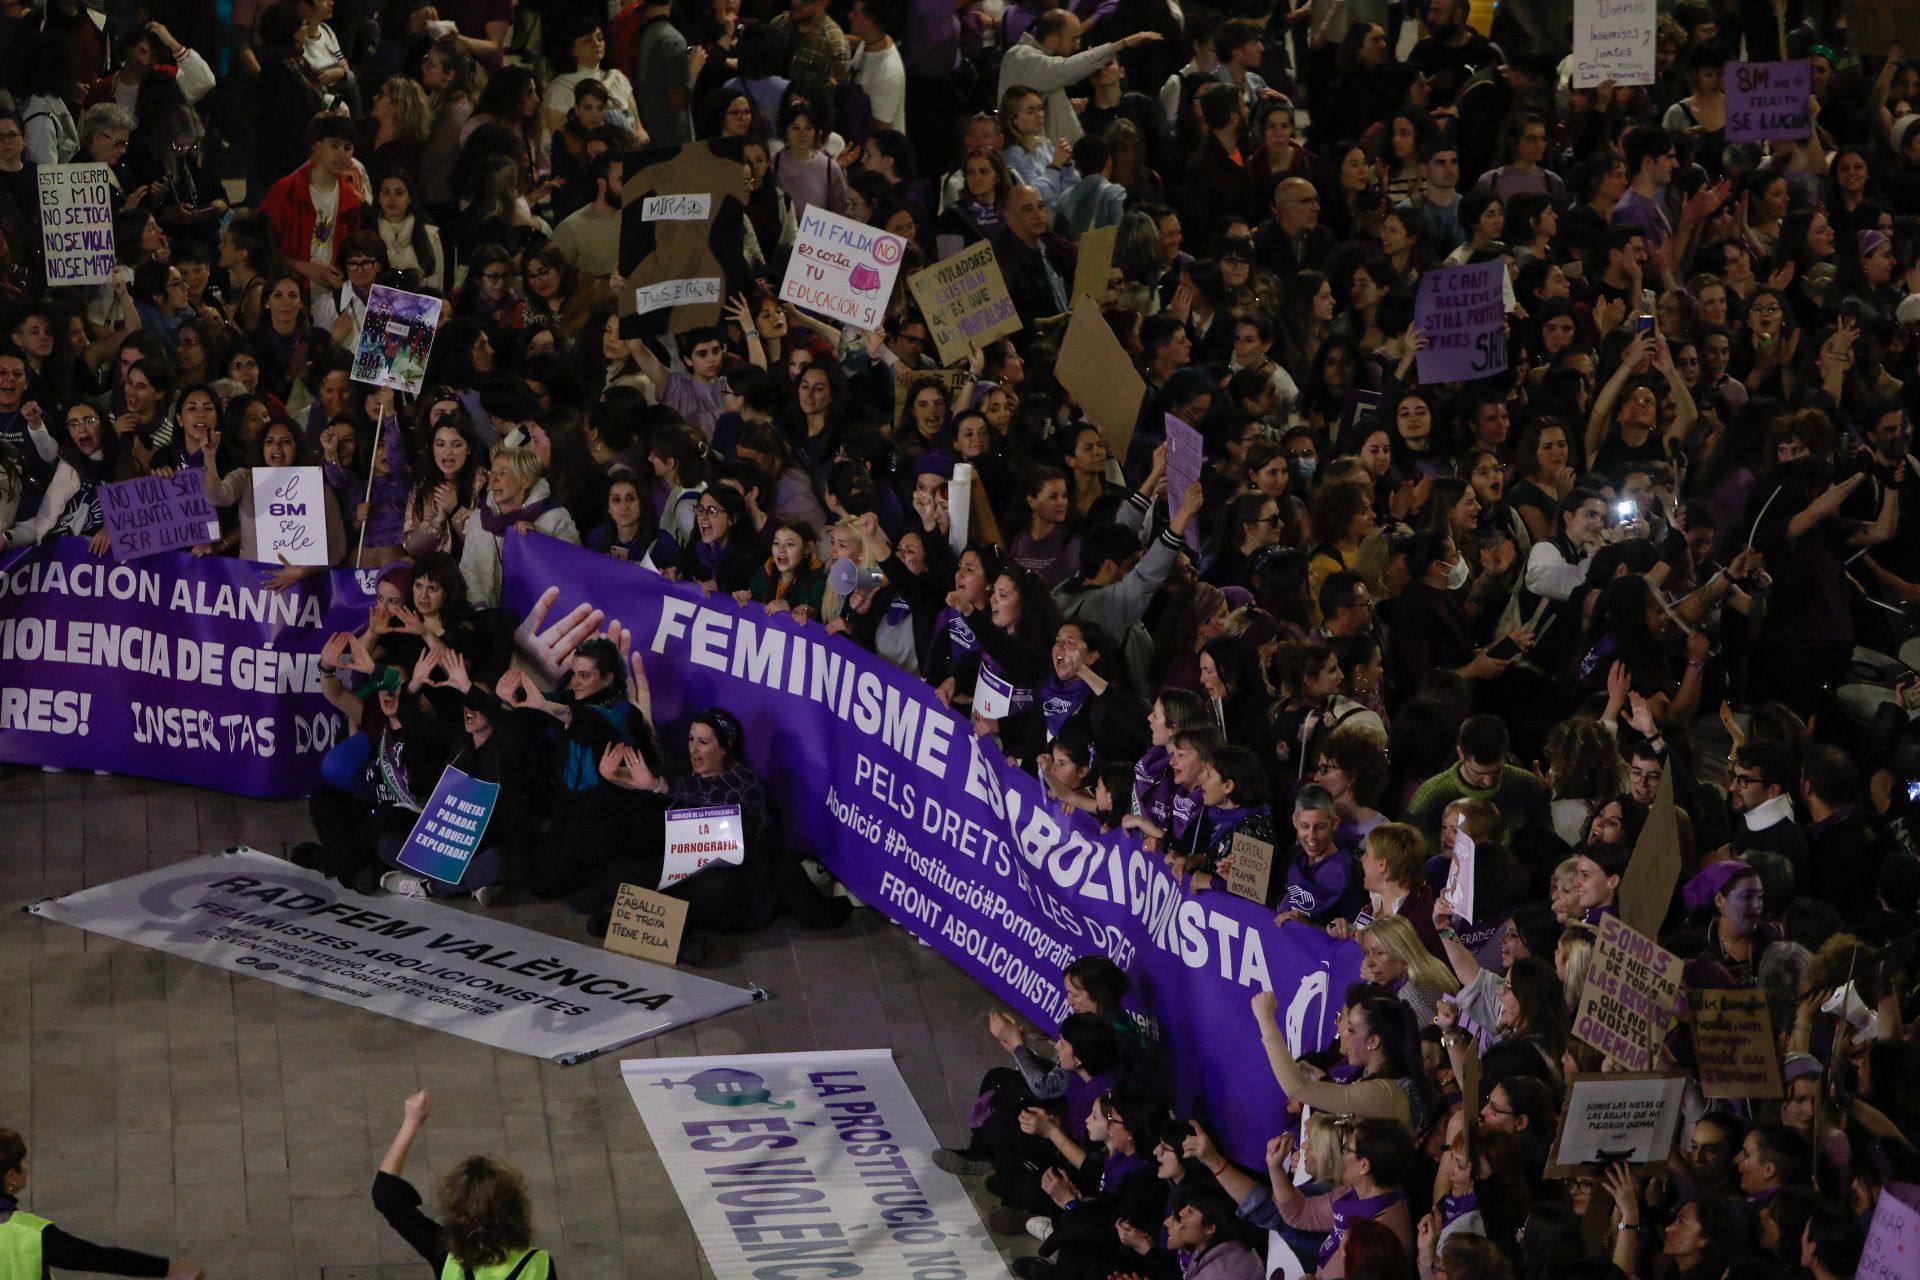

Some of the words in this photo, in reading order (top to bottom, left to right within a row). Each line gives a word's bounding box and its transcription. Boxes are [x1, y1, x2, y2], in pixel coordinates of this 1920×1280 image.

[1736, 67, 1770, 92] 8M
[1731, 112, 1752, 132] SE
[39, 172, 64, 186] ESTE
[70, 169, 109, 185] CUERPO
[42, 190, 59, 206] ES
[71, 185, 106, 206] MIO
[43, 208, 61, 227] NO
[802, 215, 826, 238] MI
[828, 224, 873, 254] FALDA
[876, 242, 898, 261] NO
[798, 243, 814, 254] es
[816, 248, 852, 269] corta
[935, 246, 994, 286] VIOLADORES
[805, 263, 825, 281] TU
[1431, 275, 1442, 293] I
[1447, 270, 1489, 291] CANT
[1435, 290, 1491, 310] BELIEVE
[862, 307, 877, 325] SI
[1423, 311, 1463, 330] STILL
[1424, 332, 1471, 351] THIS
[356, 365, 379, 380] 2023
[360, 351, 381, 369] 8M
[107, 485, 130, 512] NO
[134, 478, 172, 505] VULL
[171, 472, 203, 497] SER
[275, 475, 300, 501] el
[108, 503, 174, 532] VALENTA
[179, 498, 212, 518] VULL
[269, 503, 307, 517] 8M
[119, 531, 152, 554] SER
[160, 521, 208, 547] LLIURE
[272, 525, 316, 552] sale
[279, 520, 300, 534] se
[169, 578, 323, 630] ALANNA
[0, 615, 171, 679] IOLENCIA
[176, 637, 225, 687] DE
[230, 641, 323, 694] GÉNE
[650, 595, 956, 780] FEMINISME
[444, 793, 458, 806] NI
[457, 799, 486, 818] NIETAS
[825, 785, 881, 845] Abolició
[425, 819, 436, 833] NI
[439, 827, 475, 847] ABUELAS
[698, 823, 710, 835] LA
[414, 832, 470, 862] EXPLOTADAS
[670, 840, 738, 854] PORNOGRAFIA
[855, 753, 915, 820] PELS
[922, 796, 1011, 877] DRETS
[1035, 884, 1083, 937] LES
[619, 884, 634, 897] EL
[616, 896, 666, 916] CABALLO
[616, 908, 631, 920] DE
[634, 914, 665, 929] TROYA
[208, 875, 430, 941] RADFEM
[425, 933, 675, 1011] VALÈNCIA
[611, 922, 640, 941] TIENE
[641, 931, 669, 949] POLLA
[879, 870, 942, 929] FRONT
[940, 913, 1061, 1018] ABOLICIONISTA
[1602, 920, 1672, 975] SOMOS
[192, 901, 358, 951] FEMINISTES
[353, 948, 592, 1017] ABOLICIONISTES
[196, 929, 229, 941] ELS
[228, 938, 300, 961] VENTRES
[298, 958, 325, 968] DE
[322, 964, 398, 989] LLOGUER
[404, 987, 425, 998] EL
[1600, 941, 1626, 964] LAS
[1626, 957, 1677, 996] NIETAS
[1605, 958, 1623, 978] DE
[369, 968, 392, 977] LA
[391, 975, 504, 1012] PORNOGRAFIA,
[1588, 963, 1619, 996] LAS
[1600, 994, 1628, 1020] QUE
[1626, 1009, 1647, 1032] NO
[1578, 1015, 1649, 1071] QUEMAR
[807, 1071, 867, 1098] LA
[1586, 1102, 1612, 1111] SOMOS
[1612, 1102, 1627, 1110] LAS
[1628, 1100, 1654, 1110] NIETAS
[1586, 1112, 1602, 1121] LAS
[1633, 1111, 1648, 1120] QUE
[681, 1116, 816, 1153] ÉS
[823, 1101, 961, 1246] PROSTITUCIÓ
